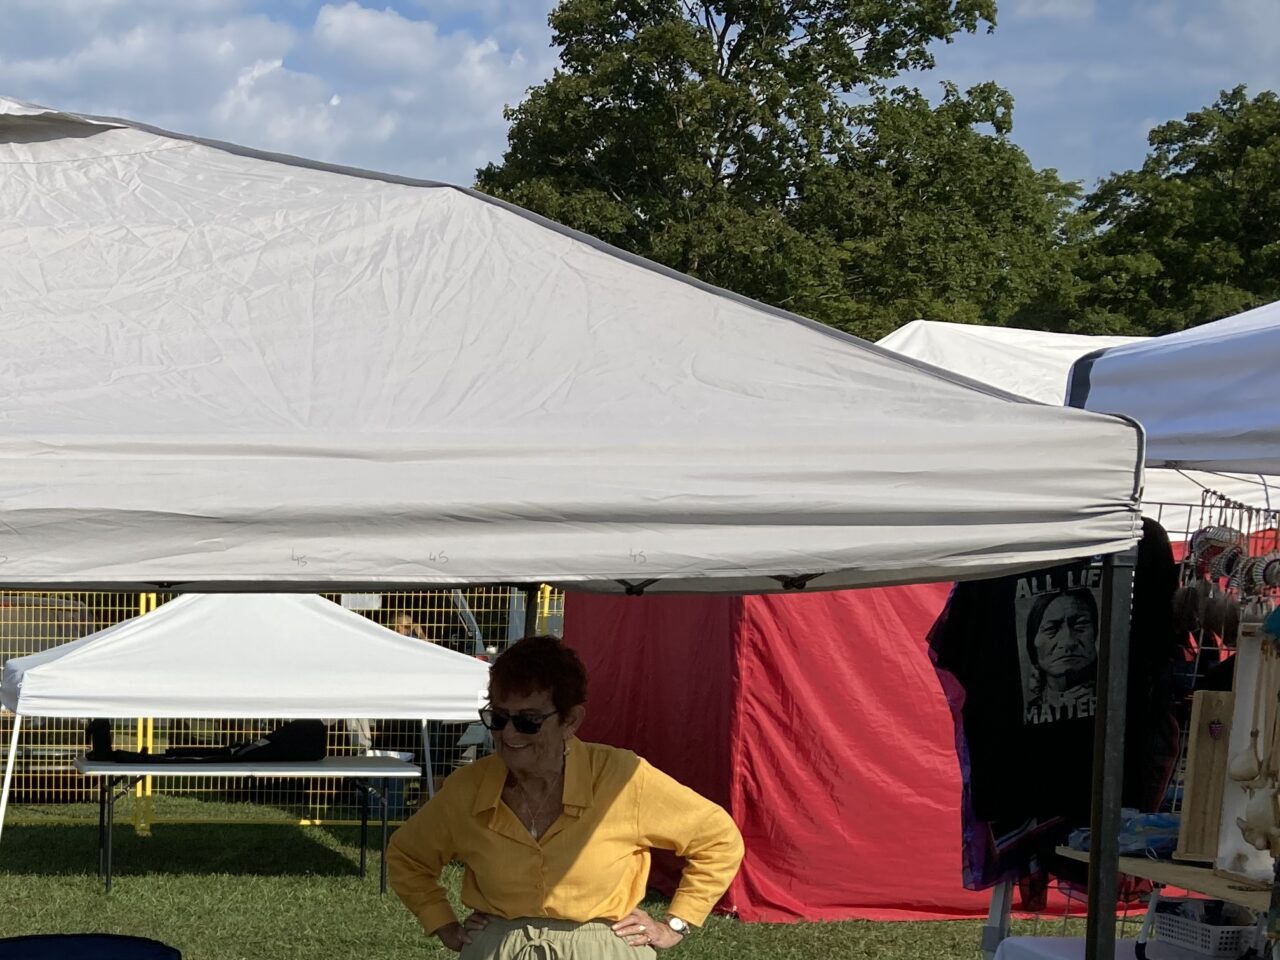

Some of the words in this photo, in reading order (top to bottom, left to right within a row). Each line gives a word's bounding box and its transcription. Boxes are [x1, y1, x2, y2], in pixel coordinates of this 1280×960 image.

[429, 550, 449, 565] 45
[630, 548, 647, 565] 45
[1016, 574, 1061, 600] ALL
[1067, 569, 1102, 592] LIF
[1023, 697, 1098, 726] MATTER
